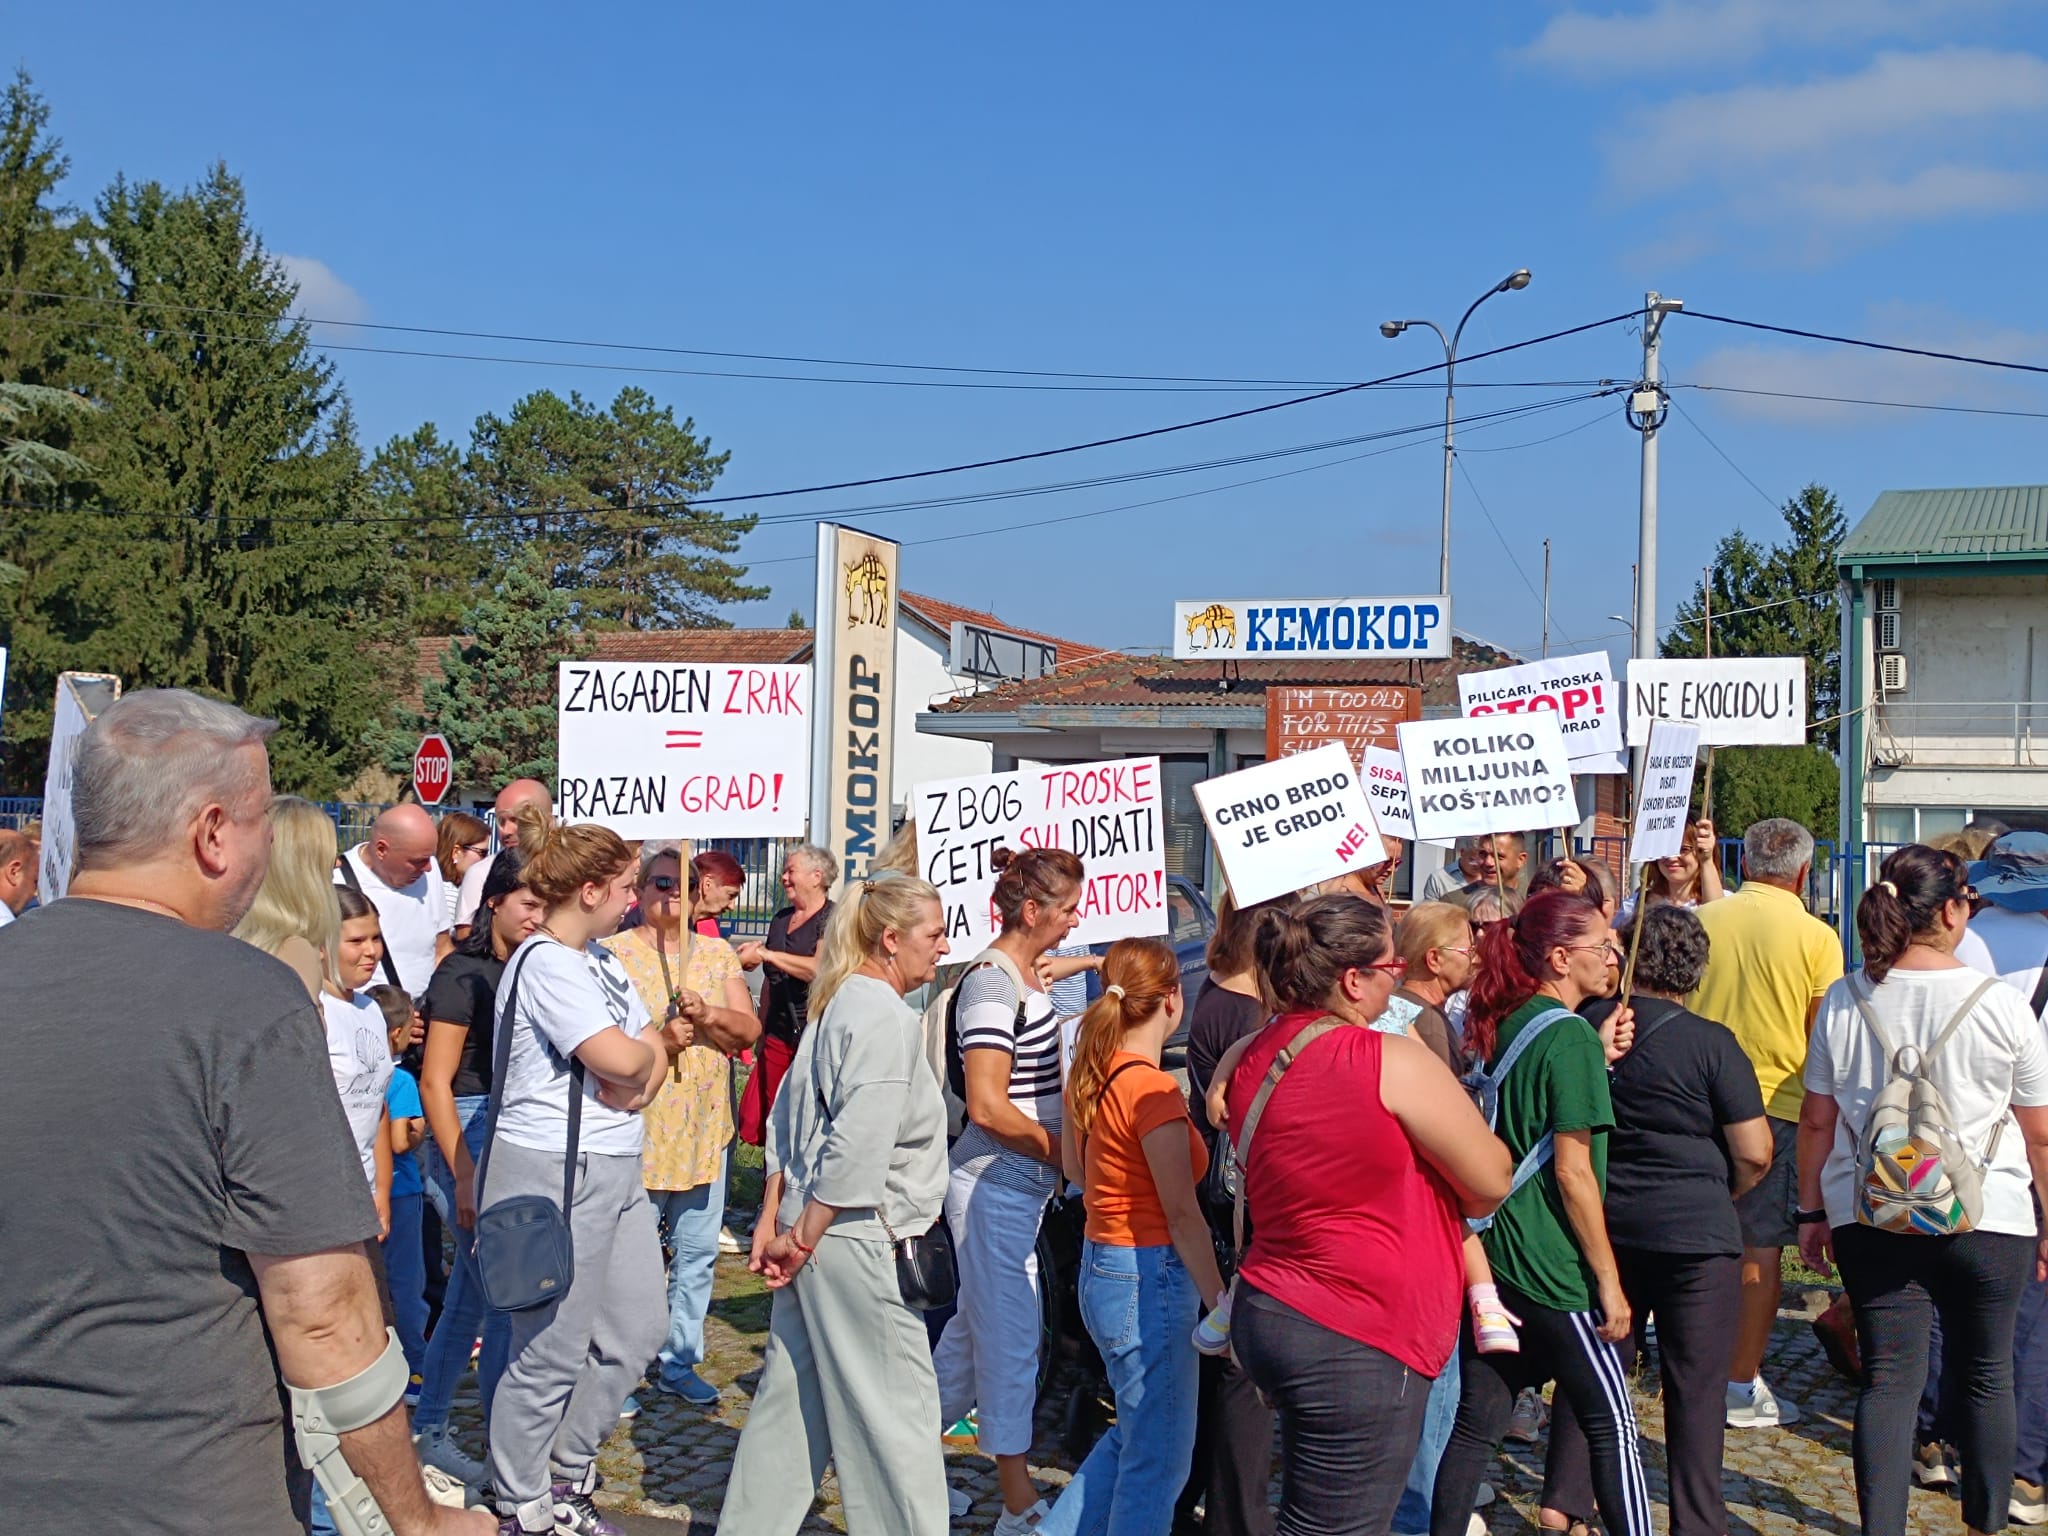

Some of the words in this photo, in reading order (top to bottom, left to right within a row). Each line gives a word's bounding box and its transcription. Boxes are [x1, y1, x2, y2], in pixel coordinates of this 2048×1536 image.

[1246, 604, 1439, 651] KEMOKOP
[723, 669, 803, 716] ZRAK
[1540, 671, 1604, 691] TROSKA
[1285, 689, 1313, 710] I'M
[1323, 690, 1368, 709] TOO
[1371, 689, 1405, 709] OLD
[1636, 682, 1670, 719] NE
[1282, 711, 1330, 735] FOR
[1337, 713, 1389, 735] THIS
[1433, 733, 1535, 757] KOLIKO
[416, 756, 448, 784] STOP
[843, 654, 880, 886] EMOKOP
[1369, 766, 1406, 784] SISA
[1421, 758, 1549, 785] MILIJUNA
[1660, 776, 1677, 790] DISATI
[560, 775, 667, 817] PRAZAN
[680, 773, 784, 813] GRAD!
[1041, 764, 1154, 810] TROSKE
[1215, 793, 1281, 826] CRNO
[1285, 772, 1350, 805] BRDO
[1371, 784, 1408, 802] SEPT
[1420, 784, 1567, 814] KOŠTAMO?
[1242, 824, 1271, 849] JE
[1274, 801, 1346, 837] GRDO!
[1381, 805, 1411, 821] JAM
[1073, 808, 1154, 859] DISATI
[1335, 822, 1370, 863] NE!
